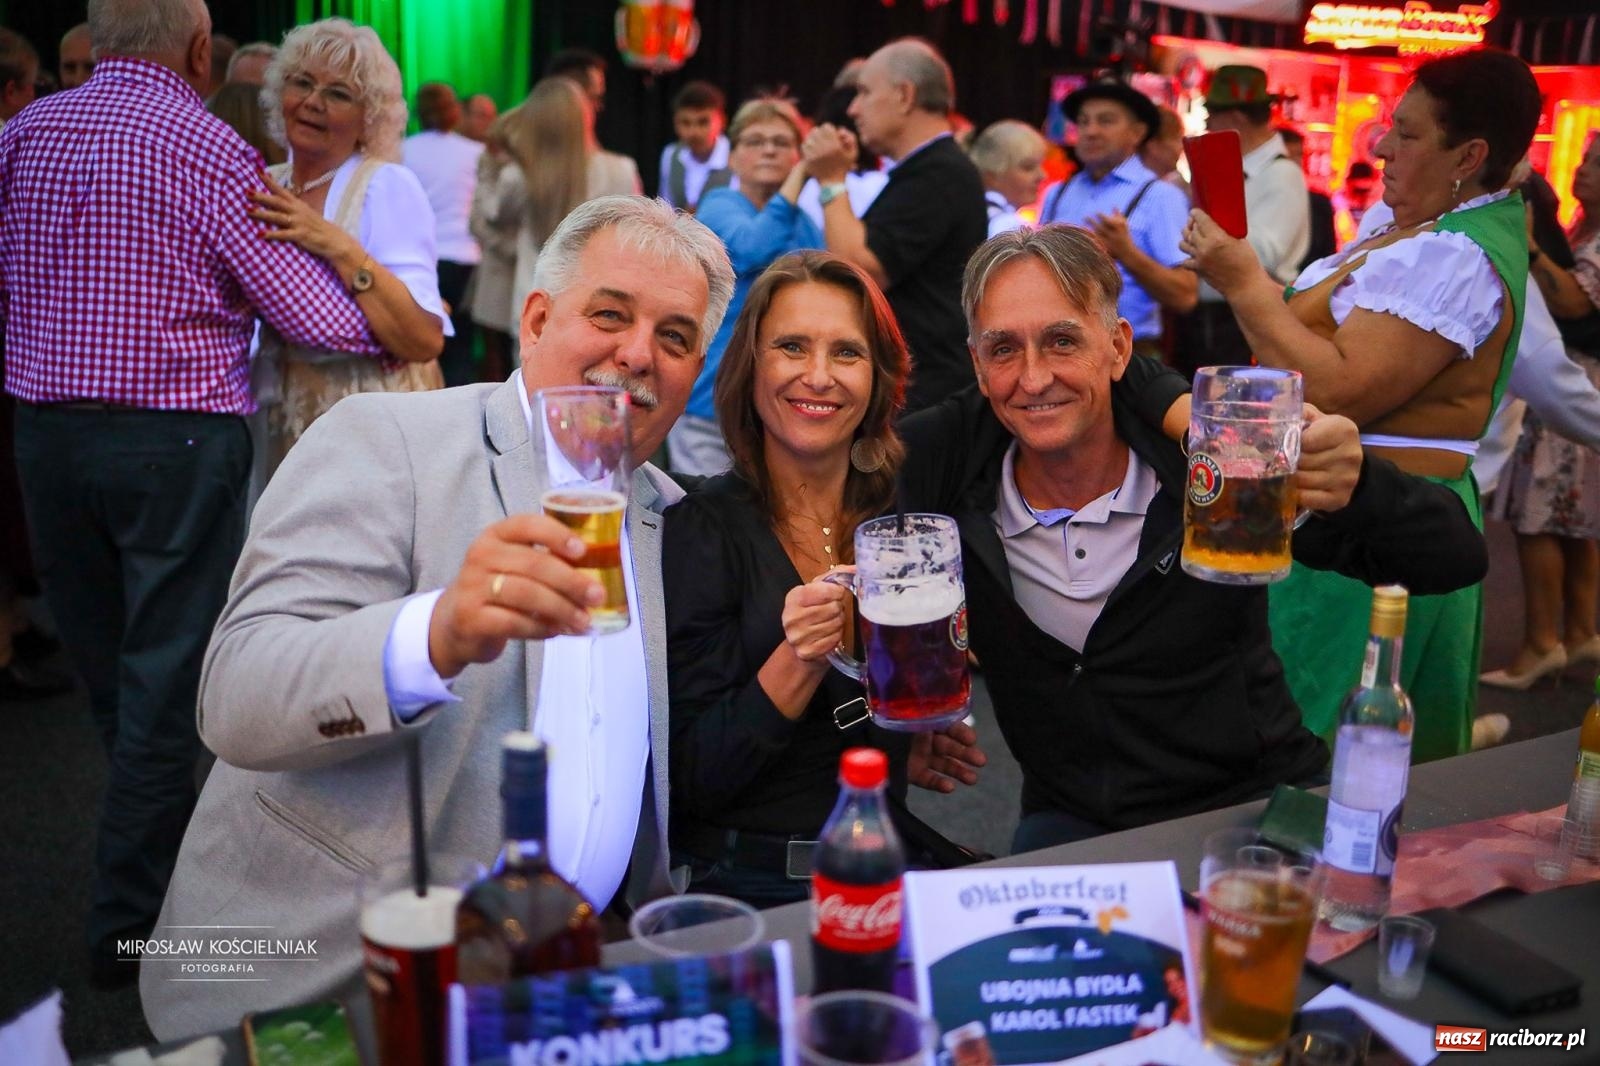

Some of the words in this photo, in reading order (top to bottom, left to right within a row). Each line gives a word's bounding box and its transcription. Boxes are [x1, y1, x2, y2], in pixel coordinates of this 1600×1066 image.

[981, 977, 1072, 1004] UBOJNIA
[991, 1008, 1062, 1032] KAROL
[1064, 1004, 1138, 1028] FASTEK
[510, 1013, 730, 1066] KONKURS
